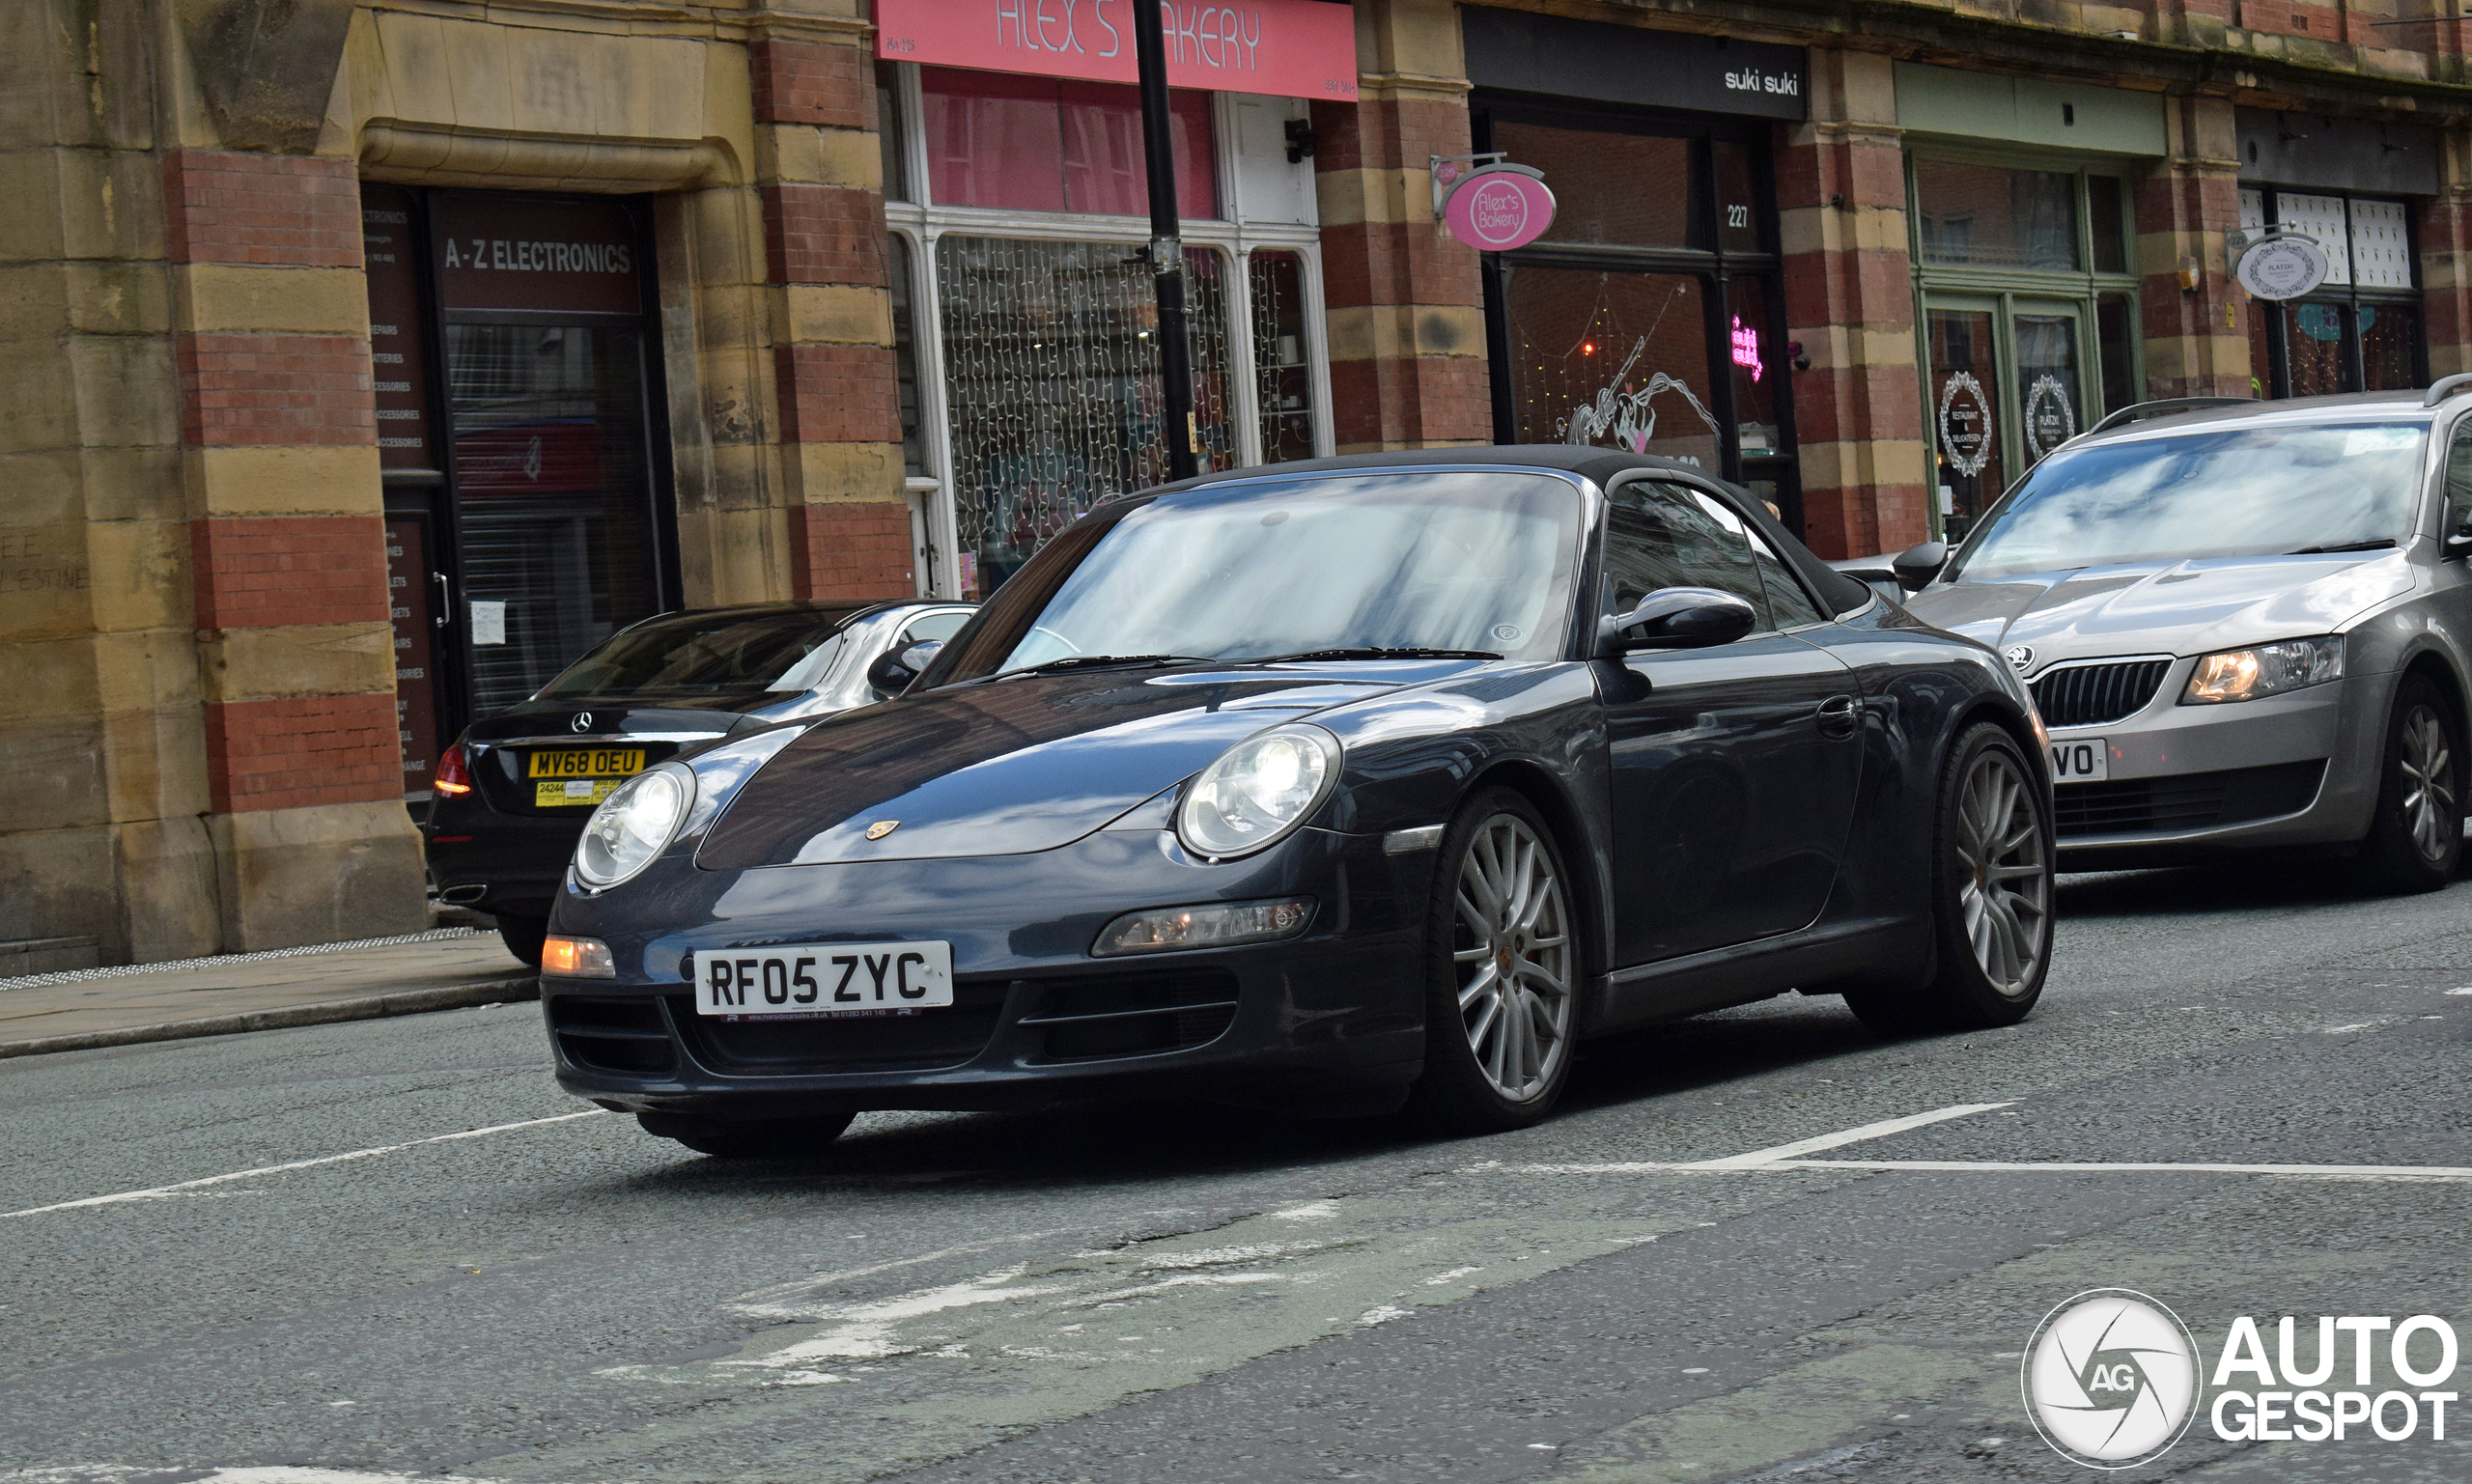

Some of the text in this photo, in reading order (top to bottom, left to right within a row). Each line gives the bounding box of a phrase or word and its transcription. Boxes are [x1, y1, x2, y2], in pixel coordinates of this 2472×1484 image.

[997, 0, 1261, 70] ALEXS AKERY
[1726, 68, 1798, 96] suki suki
[1477, 193, 1520, 211] Alex's
[1478, 210, 1520, 231] Bakery
[1728, 205, 1749, 228] 227
[492, 239, 630, 273] ELECTRONICS
[2268, 263, 2294, 271] PLATZKI
[537, 750, 636, 775] MV68 OEU
[540, 783, 564, 794] 24244
[710, 952, 927, 1006] RF05 ZYC
